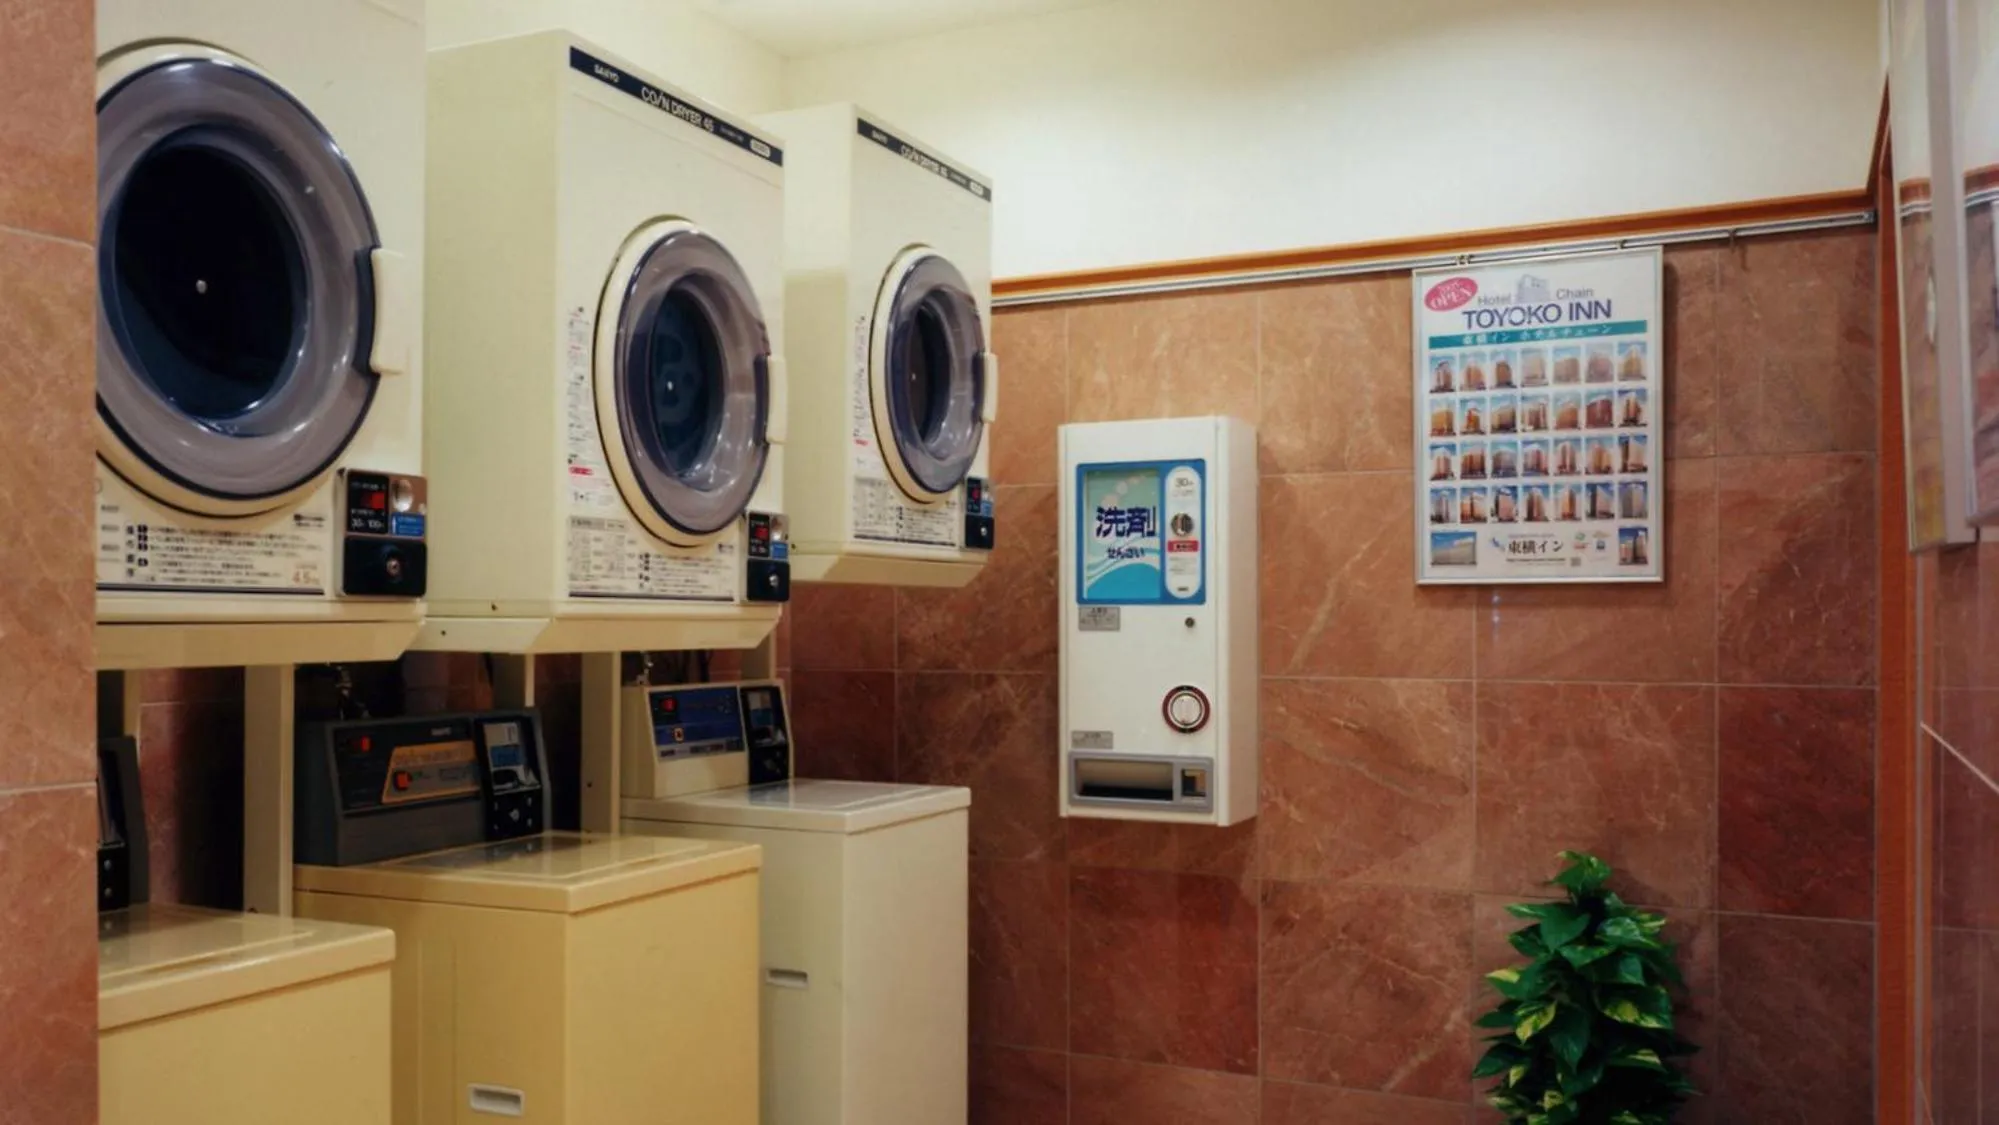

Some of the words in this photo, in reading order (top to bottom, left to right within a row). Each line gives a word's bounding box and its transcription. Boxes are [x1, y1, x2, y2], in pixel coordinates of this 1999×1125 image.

[671, 101, 702, 127] DRYER
[1477, 293, 1512, 306] Hotel
[1555, 286, 1595, 301] Chain
[1462, 303, 1562, 330] TOYOKO
[1568, 299, 1613, 322] INN
[1096, 505, 1156, 538] 洗剤
[1508, 540, 1564, 554] 東横イン
